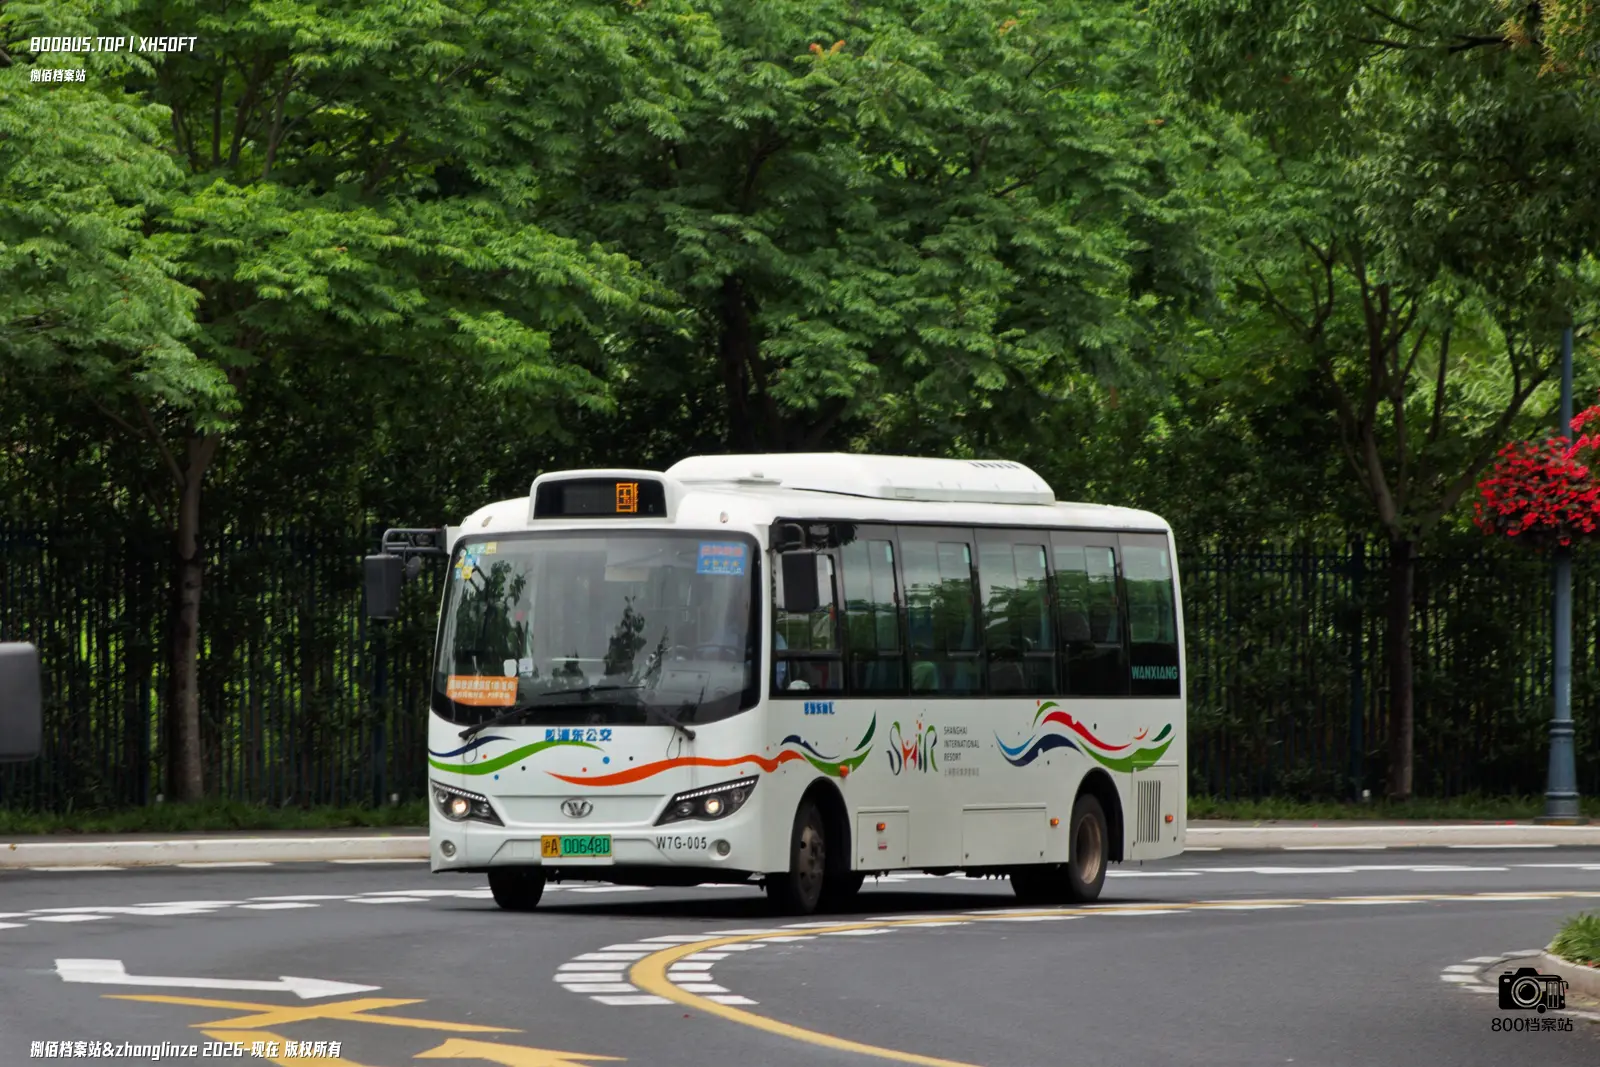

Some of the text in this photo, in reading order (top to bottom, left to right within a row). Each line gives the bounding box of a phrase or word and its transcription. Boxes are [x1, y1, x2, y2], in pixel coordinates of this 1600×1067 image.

[1131, 665, 1178, 680] WANXIANG
[943, 725, 968, 736] SHANGHAI
[943, 739, 980, 749] INTERNATIONAL
[943, 752, 962, 762] RESORT
[656, 836, 707, 850] W7G-005
